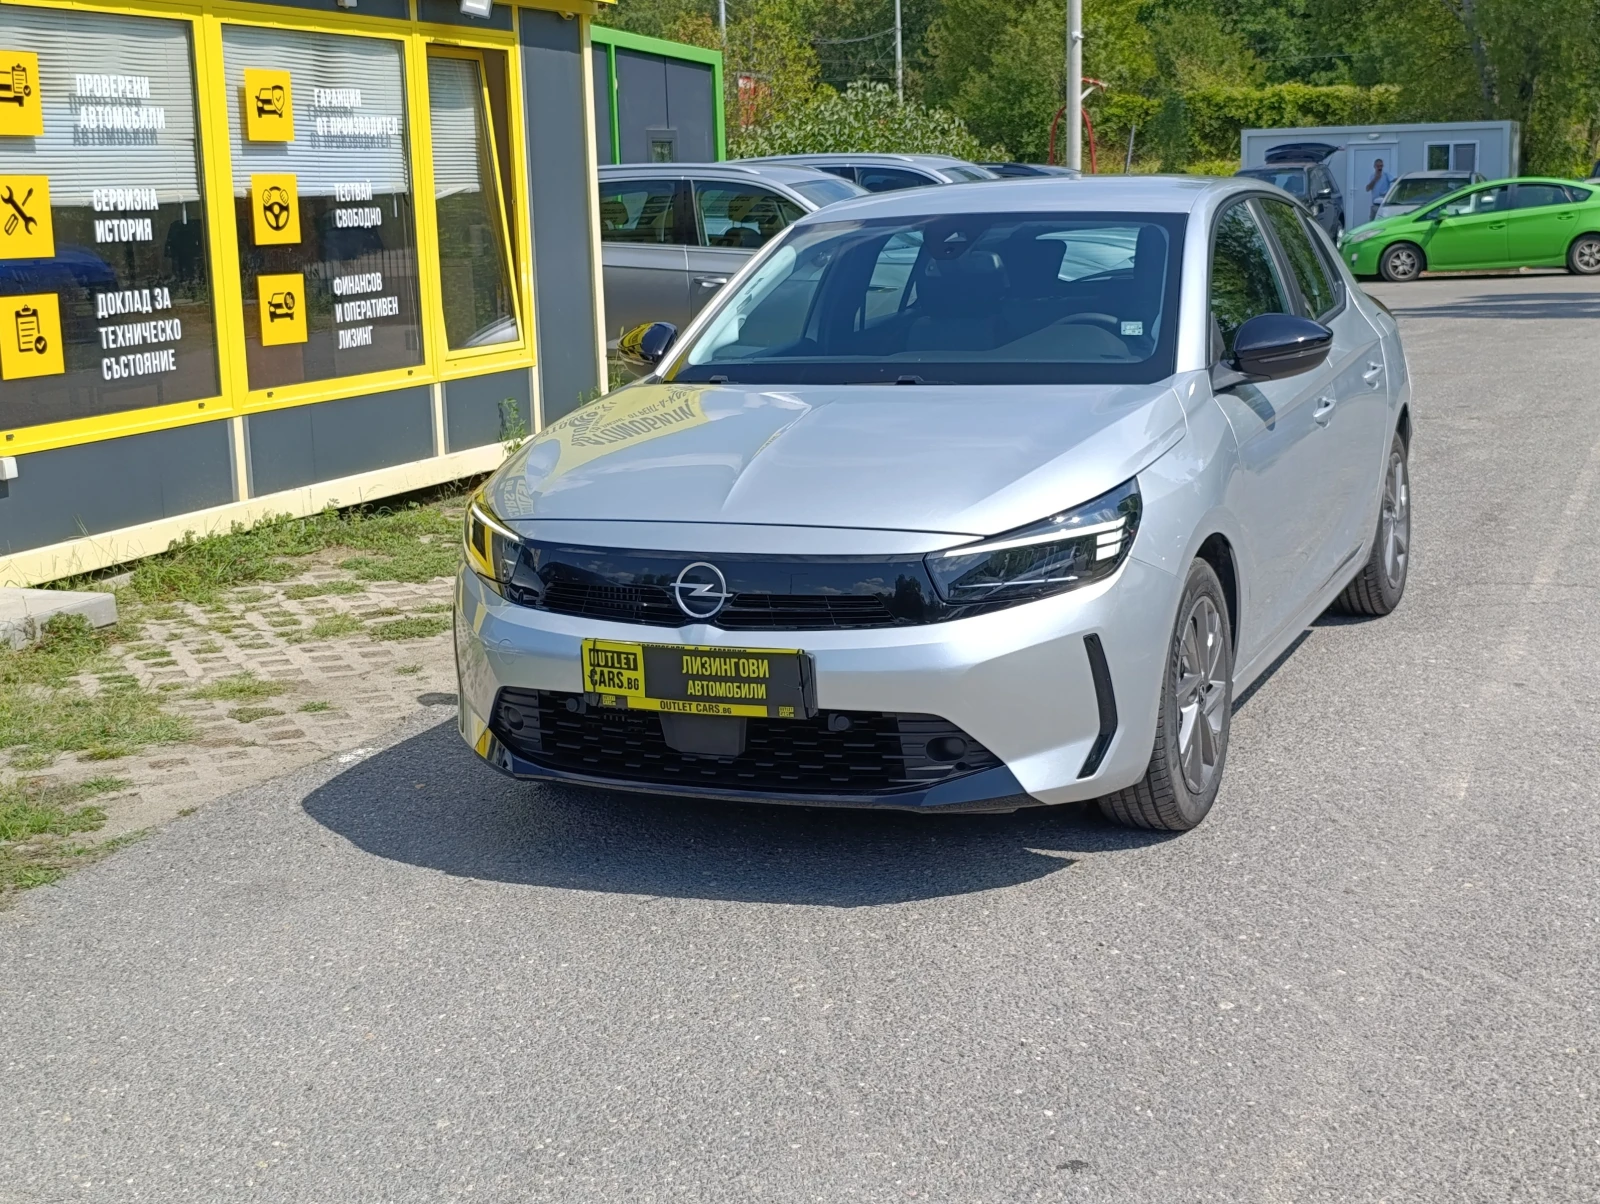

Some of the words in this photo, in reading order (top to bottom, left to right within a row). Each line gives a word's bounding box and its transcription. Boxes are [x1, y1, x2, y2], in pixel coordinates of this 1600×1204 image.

[76, 74, 150, 98] ПРОВЕРЕНИ
[314, 88, 362, 109] ГАРАНЦИЯ
[80, 106, 166, 129] АВТОМОБИЛИ
[316, 117, 328, 135] ОТ
[330, 117, 399, 137] ПРОИЗВОДИТЕЛ
[93, 188, 159, 212] СЕРВИЗНА
[334, 180, 373, 202] ТЕСТВАЙ
[335, 207, 382, 229] СВОБОДНО
[94, 219, 153, 243] ИСТОРИЯ
[333, 272, 383, 296] ФИНАНСОВ
[96, 289, 152, 319] ДОКЛАД
[154, 287, 171, 310] ЗА
[335, 303, 343, 323] И
[344, 296, 399, 322] ОПЕРАТИВЕН
[98, 318, 182, 350] ТЕХНИЧЕСКО
[338, 325, 373, 350] ЛИЗИНГ
[102, 349, 177, 380] СЪСТОЯНИЕ
[590, 650, 635, 669] OUTLET
[682, 656, 769, 678] ЛИЗИНГОВИ
[590, 668, 640, 691] CARS.BG
[687, 680, 766, 699] АВТОМОБИЛИ
[660, 700, 693, 712] OUTLET
[696, 703, 732, 714] CARS.BG
